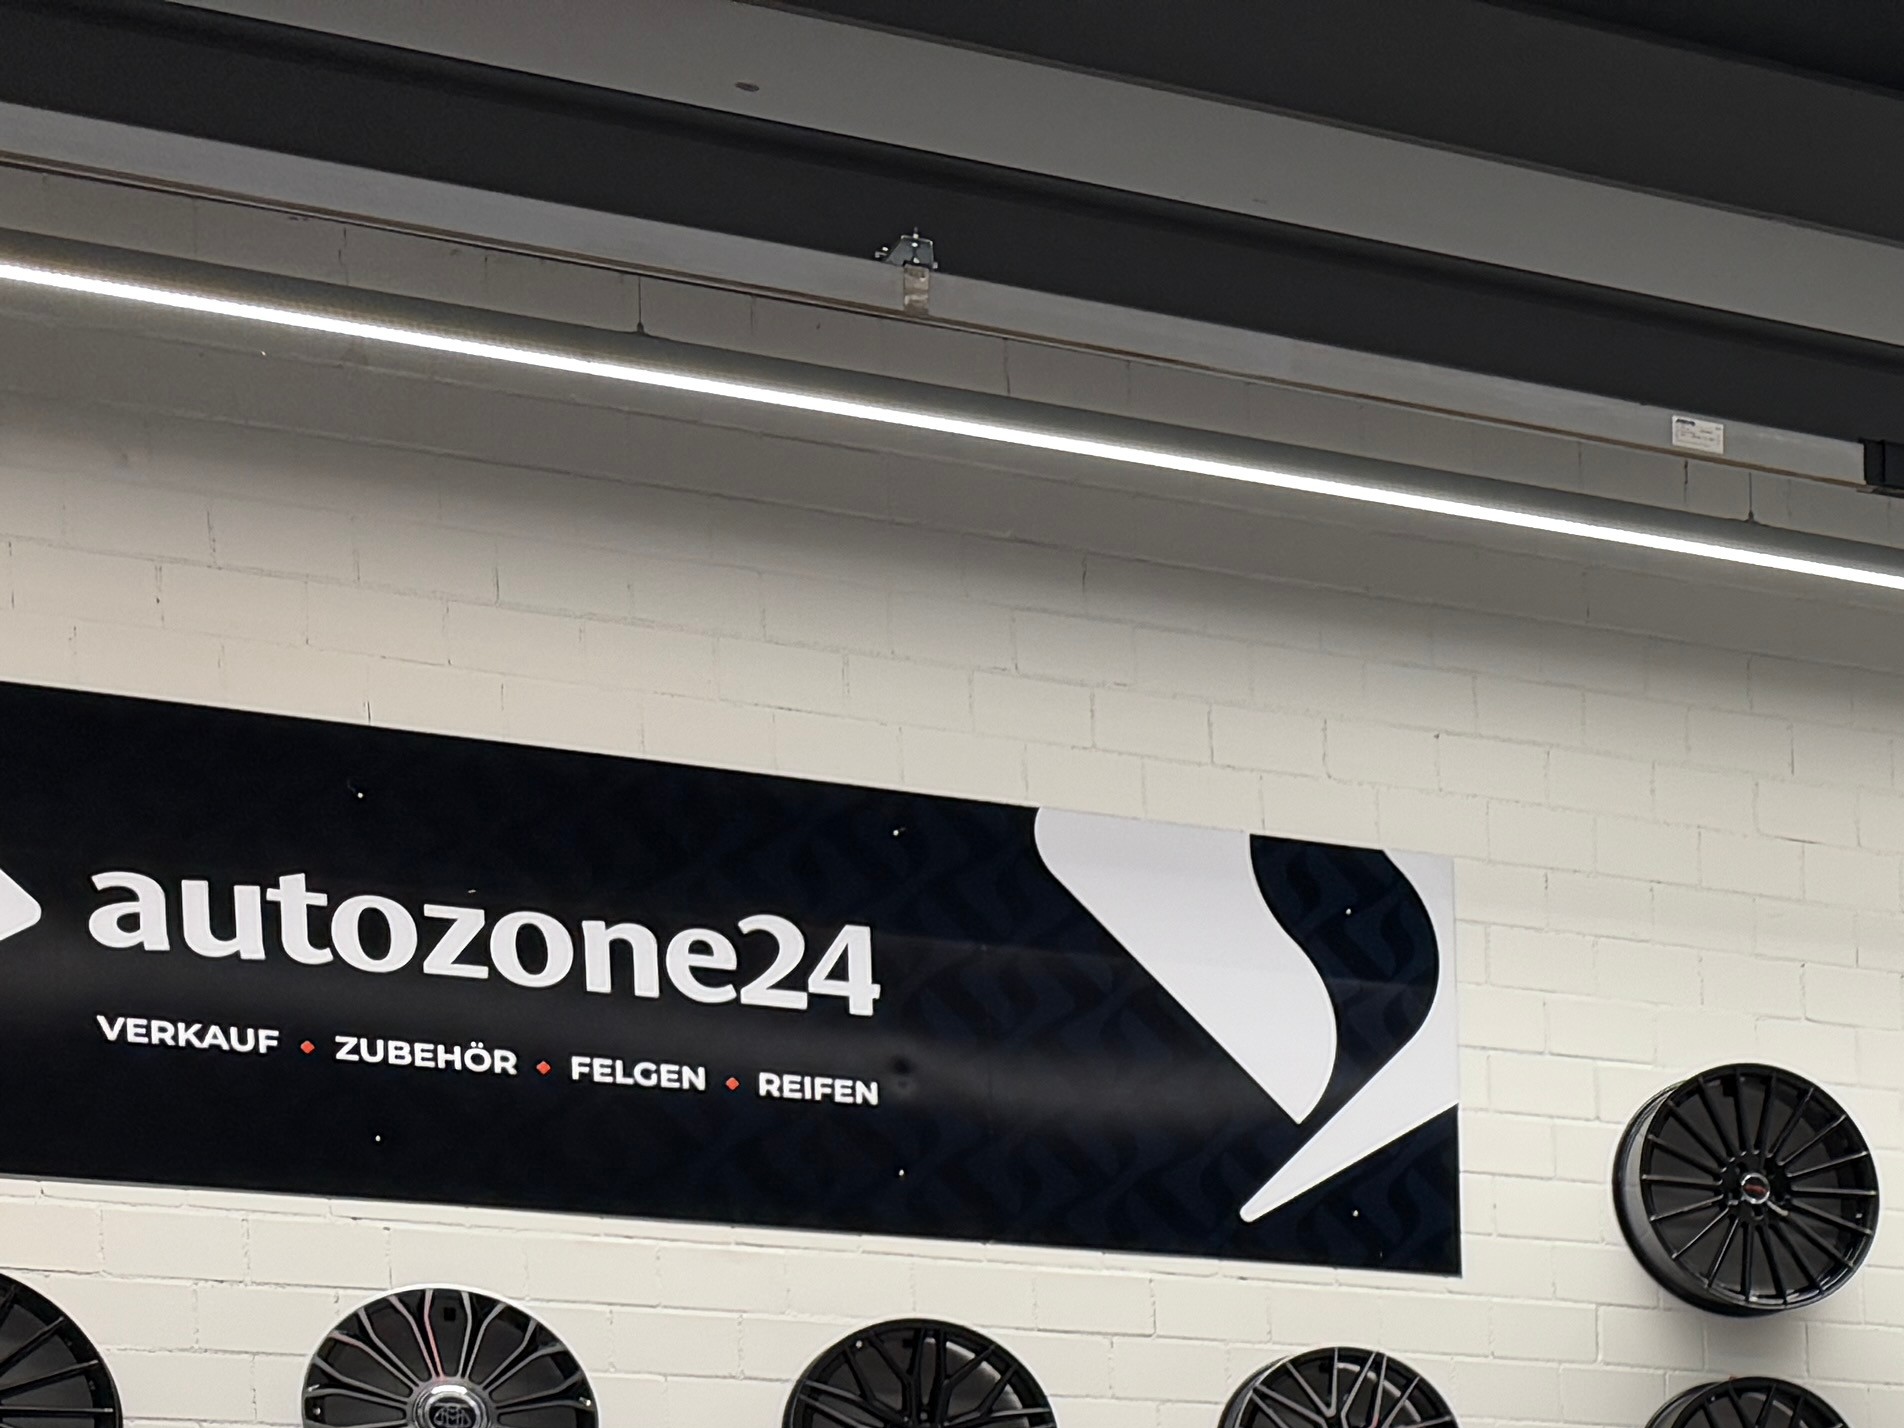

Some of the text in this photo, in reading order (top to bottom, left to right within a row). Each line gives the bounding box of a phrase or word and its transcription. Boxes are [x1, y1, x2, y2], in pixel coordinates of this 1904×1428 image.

[88, 871, 881, 1016] autozone24
[96, 1014, 879, 1106] VERKAUF ZUBEHÖR FELGEN REIFEN
